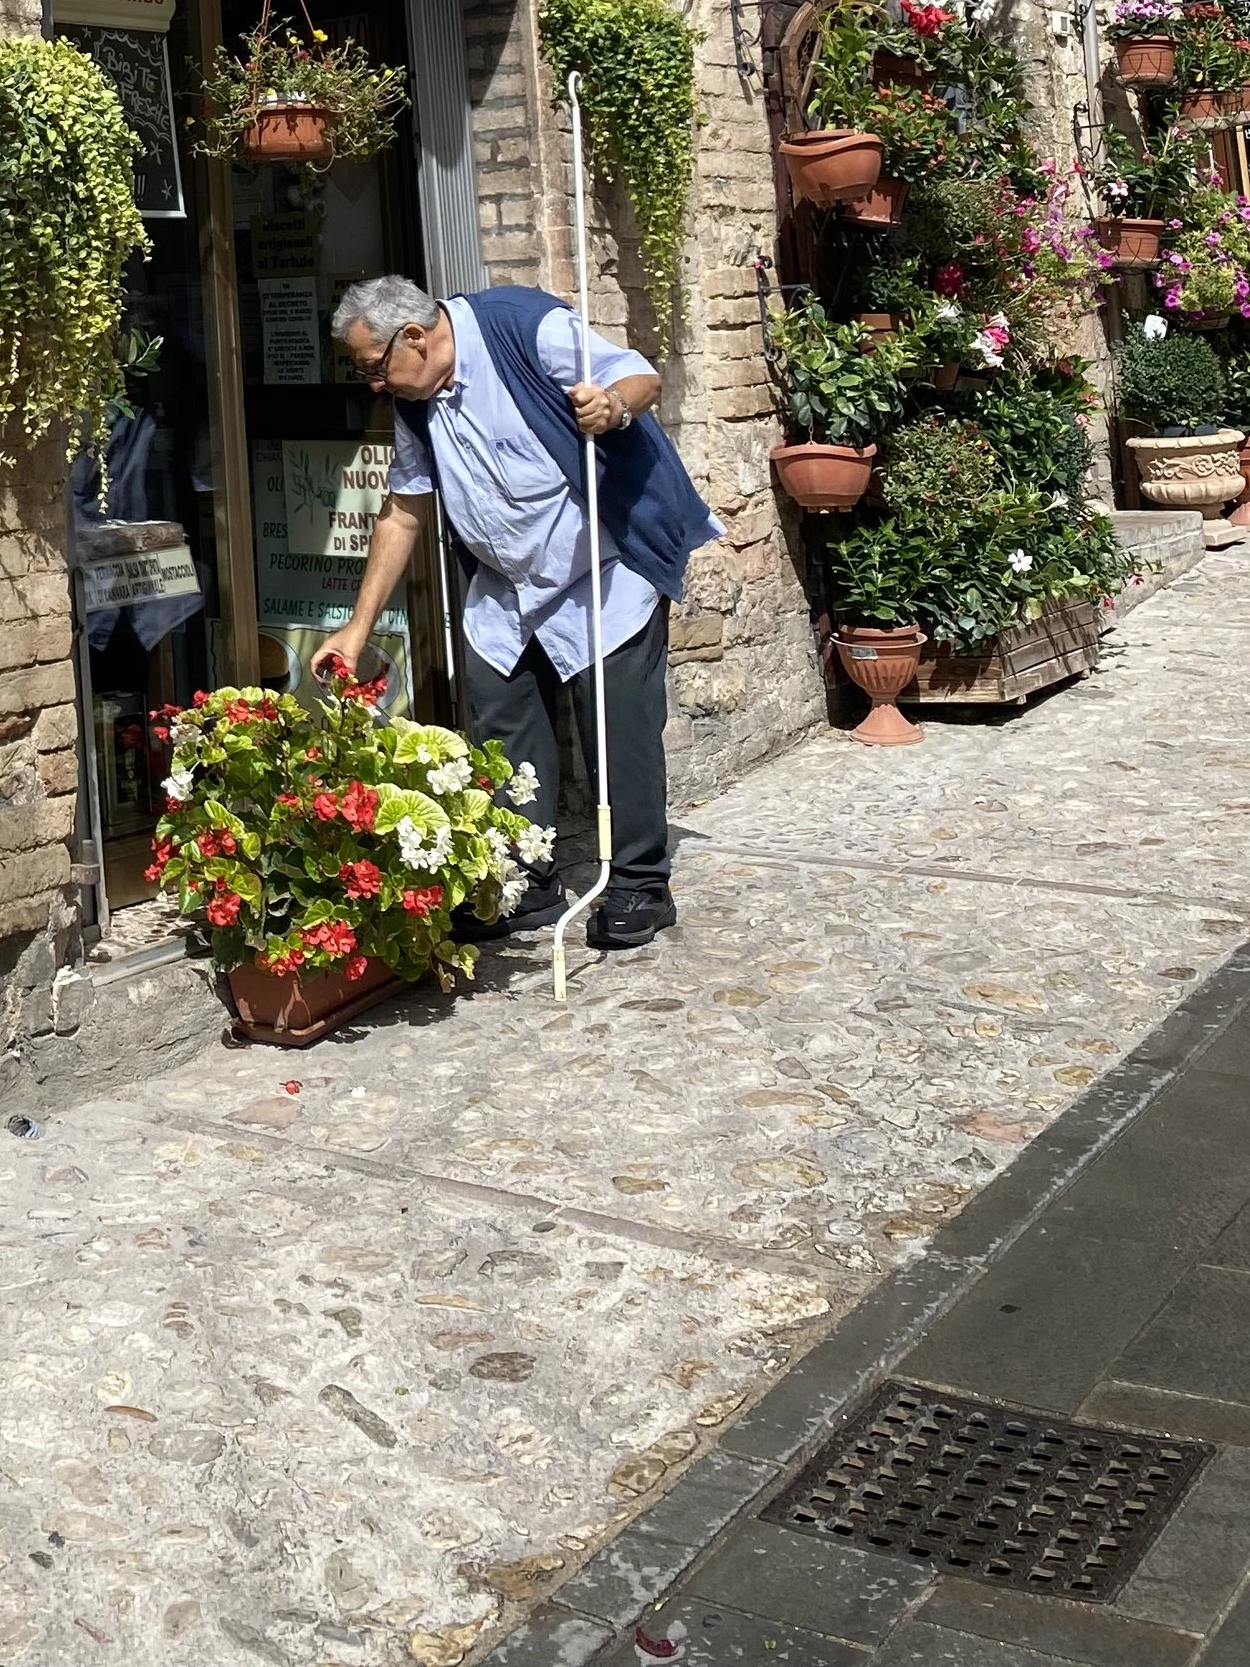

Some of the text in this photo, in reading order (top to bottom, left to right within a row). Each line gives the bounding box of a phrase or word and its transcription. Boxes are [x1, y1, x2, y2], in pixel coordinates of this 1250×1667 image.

[271, 254, 315, 270] Tartufo
[334, 533, 372, 552] DI SP
[270, 553, 367, 576] PECORINO PRO
[322, 577, 348, 592] LATTE
[263, 598, 304, 617] SALAME
[307, 601, 314, 617] E
